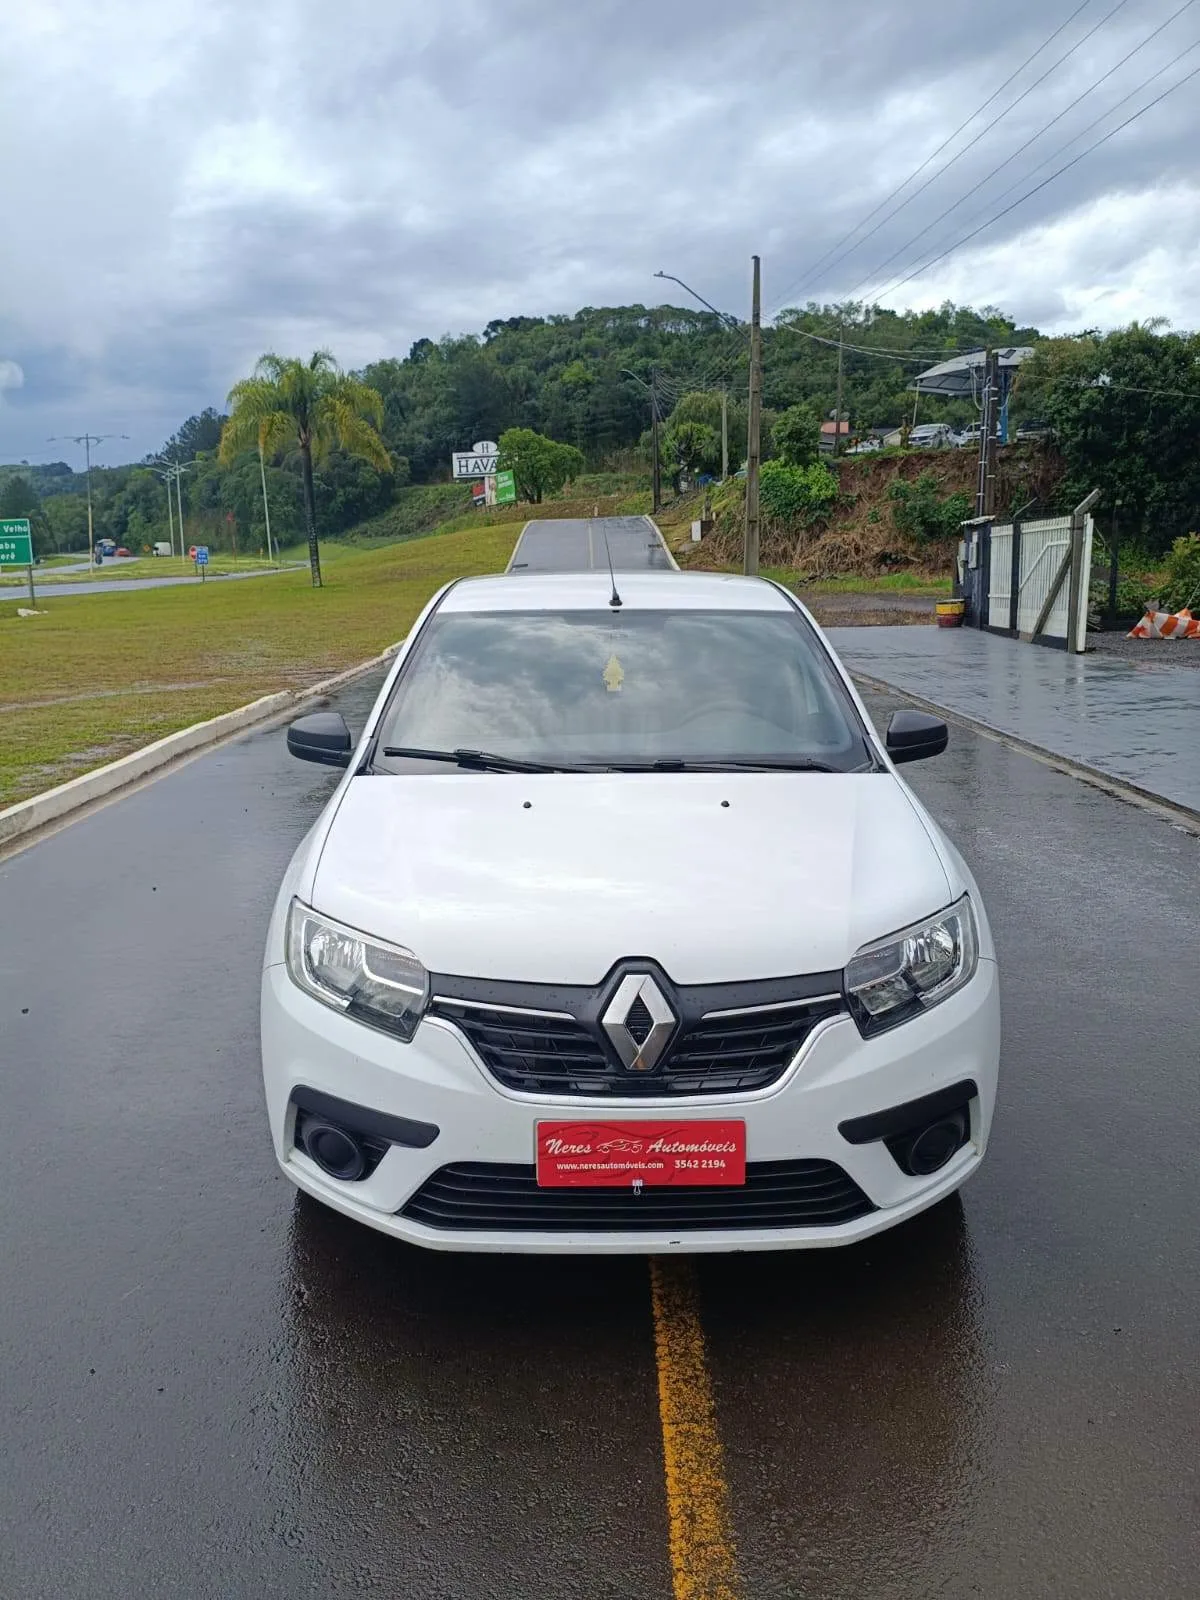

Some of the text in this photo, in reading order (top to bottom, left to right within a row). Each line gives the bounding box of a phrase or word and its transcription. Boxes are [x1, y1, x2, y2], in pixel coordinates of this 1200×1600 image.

[481, 442, 489, 454] H
[457, 458, 497, 473] HAVA
[3, 524, 28, 533] Velho
[545, 1138, 737, 1154] Neres Automóveis
[556, 1159, 726, 1170] www.neresautomóveis.com 3542 2194
